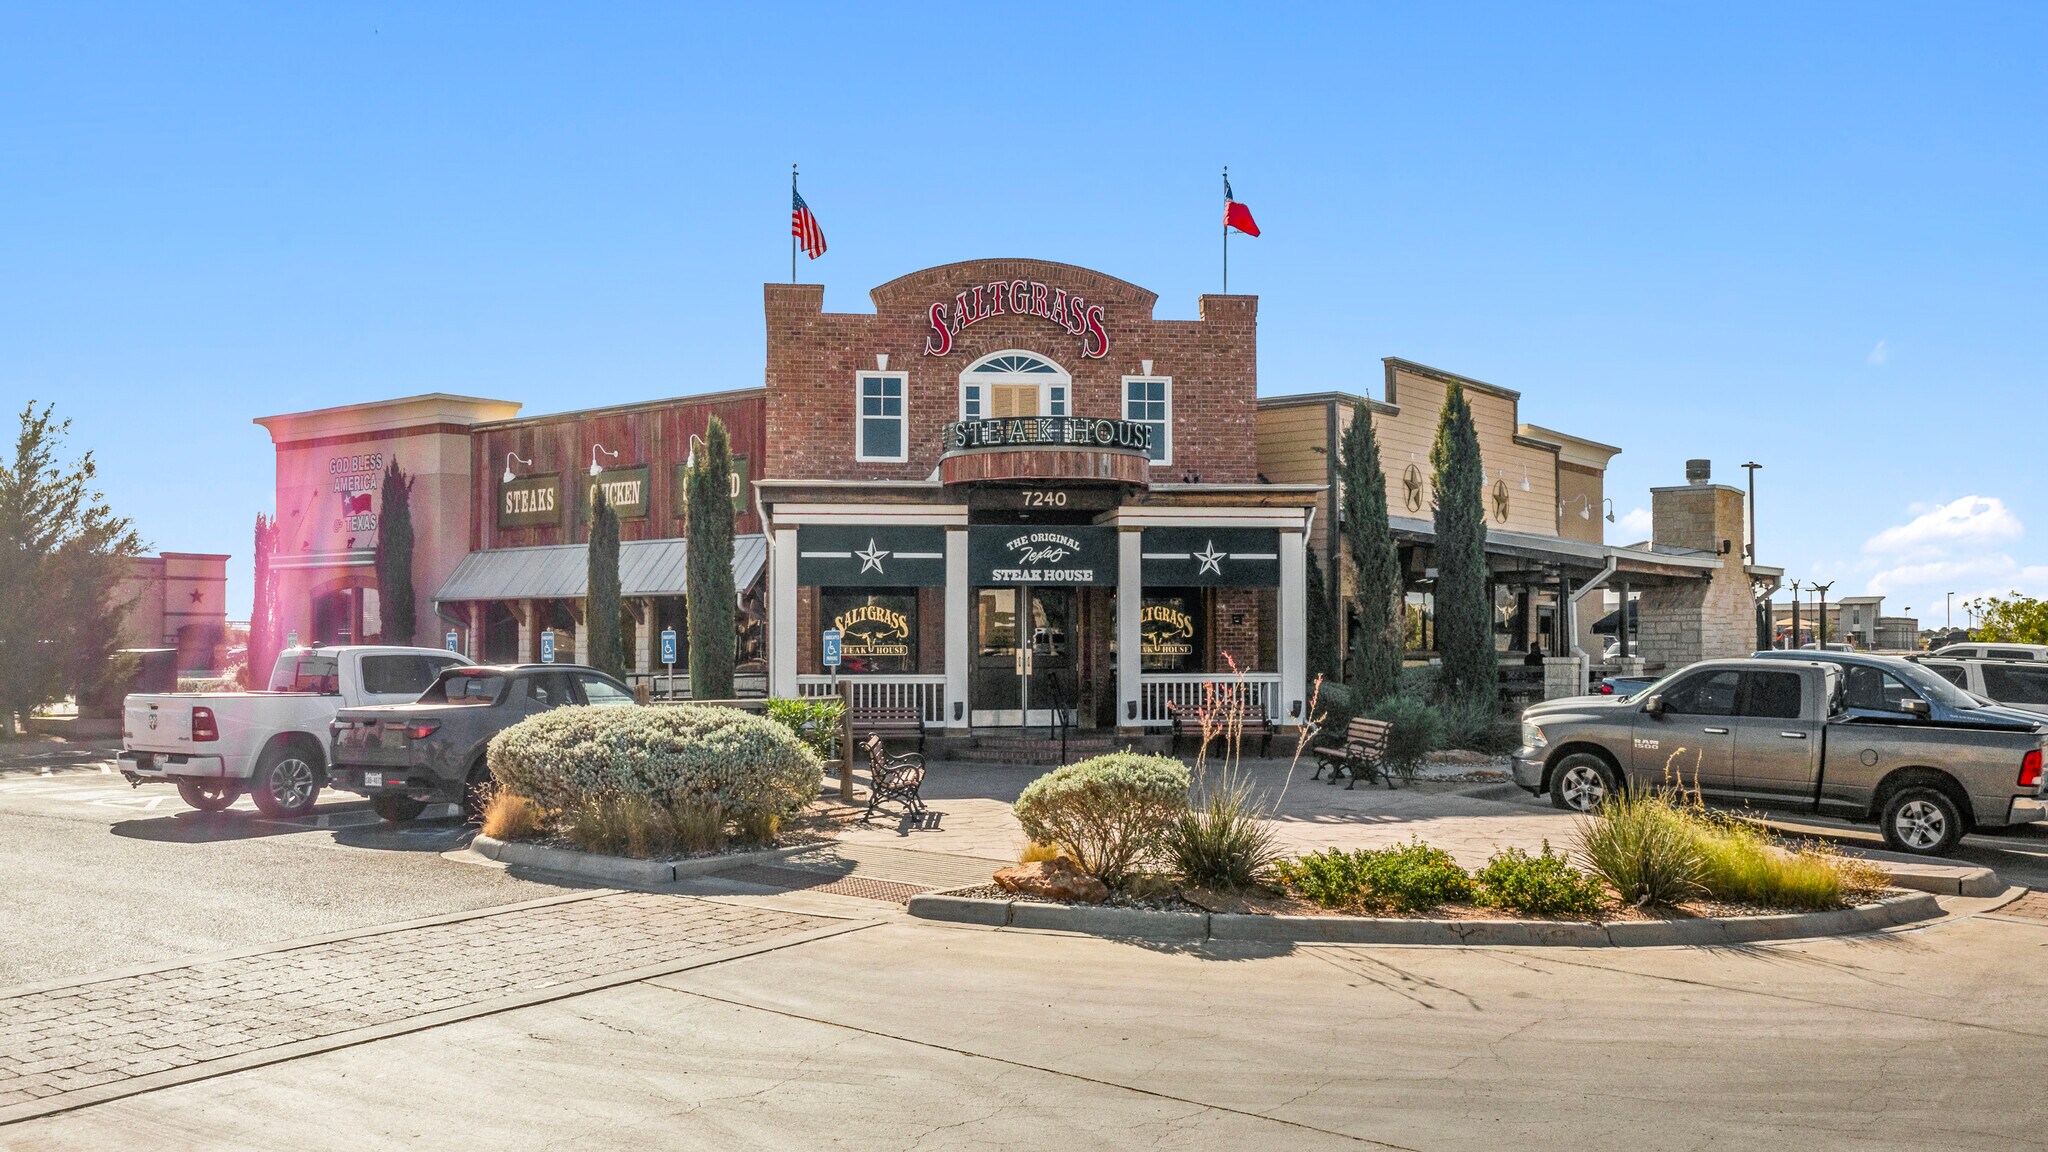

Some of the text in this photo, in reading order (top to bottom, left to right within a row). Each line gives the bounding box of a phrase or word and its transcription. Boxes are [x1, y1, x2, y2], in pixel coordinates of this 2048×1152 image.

[923, 279, 1110, 359] SALTGRASS
[955, 418, 1153, 449] STEAK HOUSE
[329, 452, 383, 475] GOD BLESS
[333, 473, 377, 493] AMERICA
[505, 487, 554, 514] STEAKS
[1022, 491, 1067, 506] 7240
[345, 513, 377, 532] TEXAS
[1006, 533, 1081, 551] THE ORIGINAL
[1019, 546, 1070, 565] Texas
[992, 569, 1094, 582] STEAK HOUSE
[834, 605, 909, 639] SALTGRASS
[876, 646, 905, 654] HOUSE
